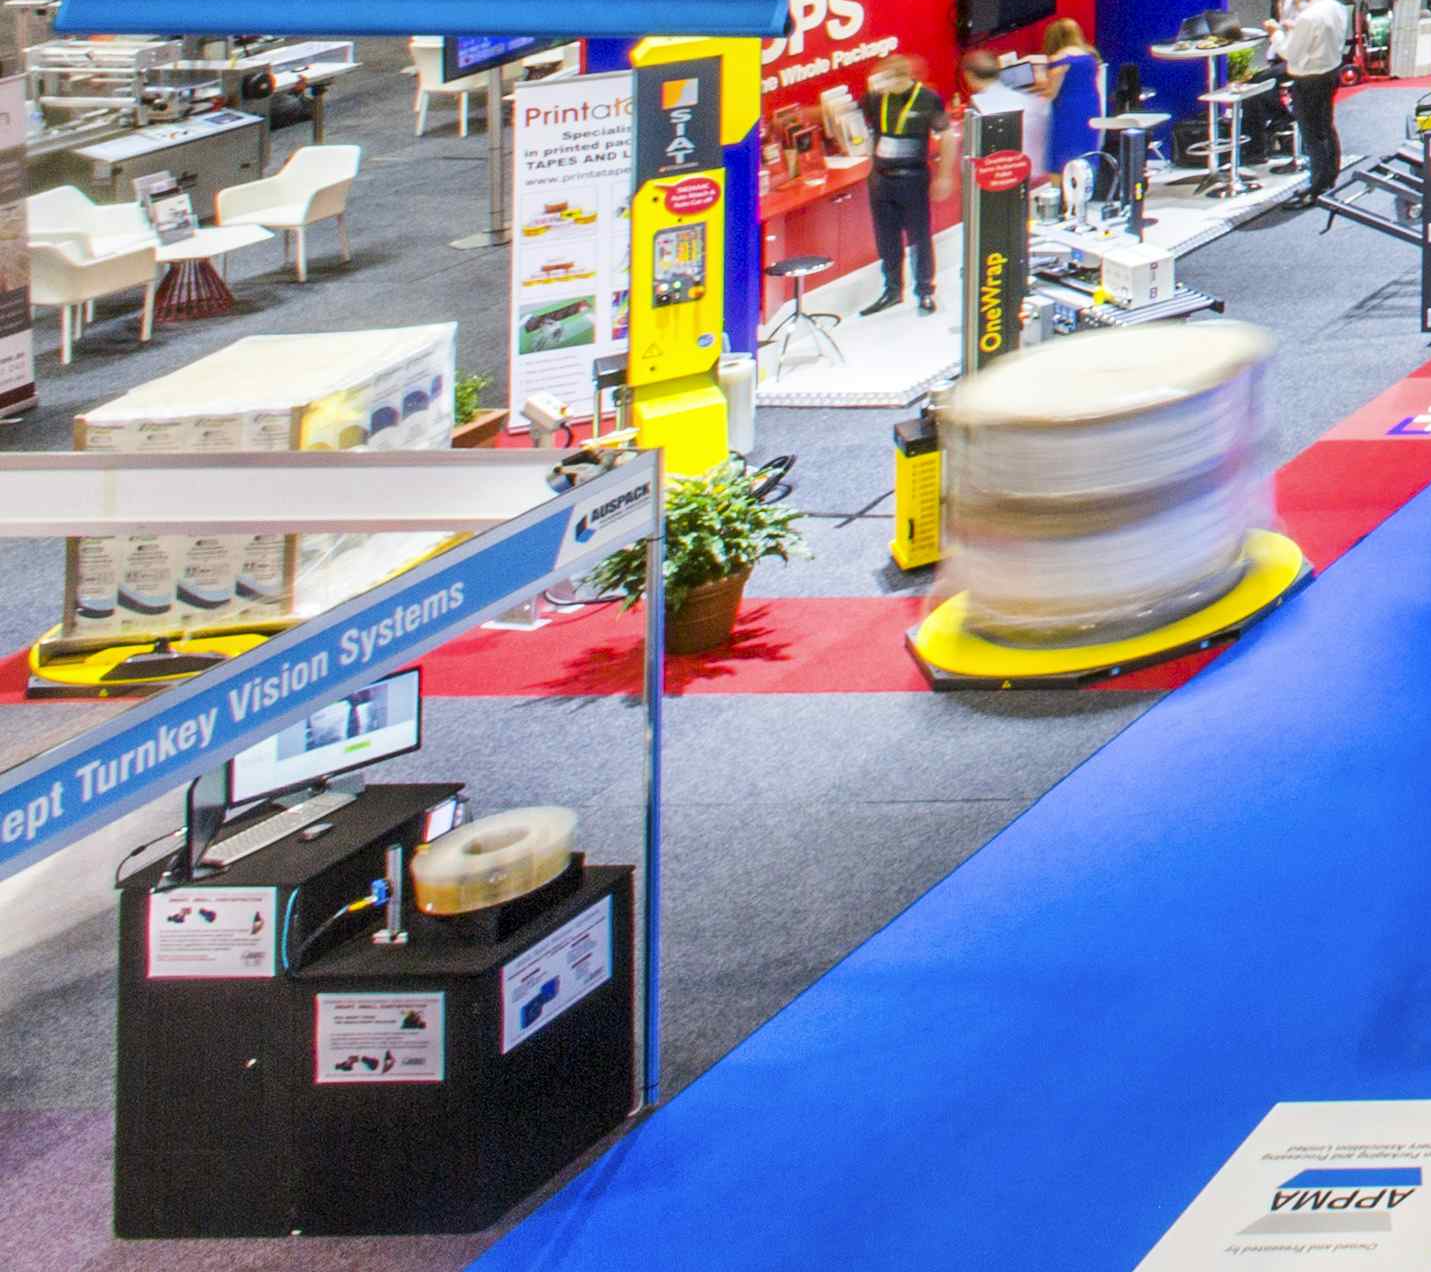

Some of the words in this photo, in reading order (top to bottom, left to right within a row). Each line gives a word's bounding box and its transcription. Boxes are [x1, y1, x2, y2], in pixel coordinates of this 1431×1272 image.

[780, 58, 830, 87] Whole
[831, 36, 899, 70] Package
[543, 143, 600, 157] printed
[665, 108, 696, 165] SIAT
[526, 157, 577, 171] TAPES
[583, 152, 617, 164] AND
[979, 252, 1007, 353] OneWrap
[589, 479, 652, 524] AUSPACK
[76, 706, 217, 804] Turnkey
[227, 648, 330, 724] Vision
[338, 576, 466, 667] Systems
[1270, 1188, 1416, 1212] APPMA
